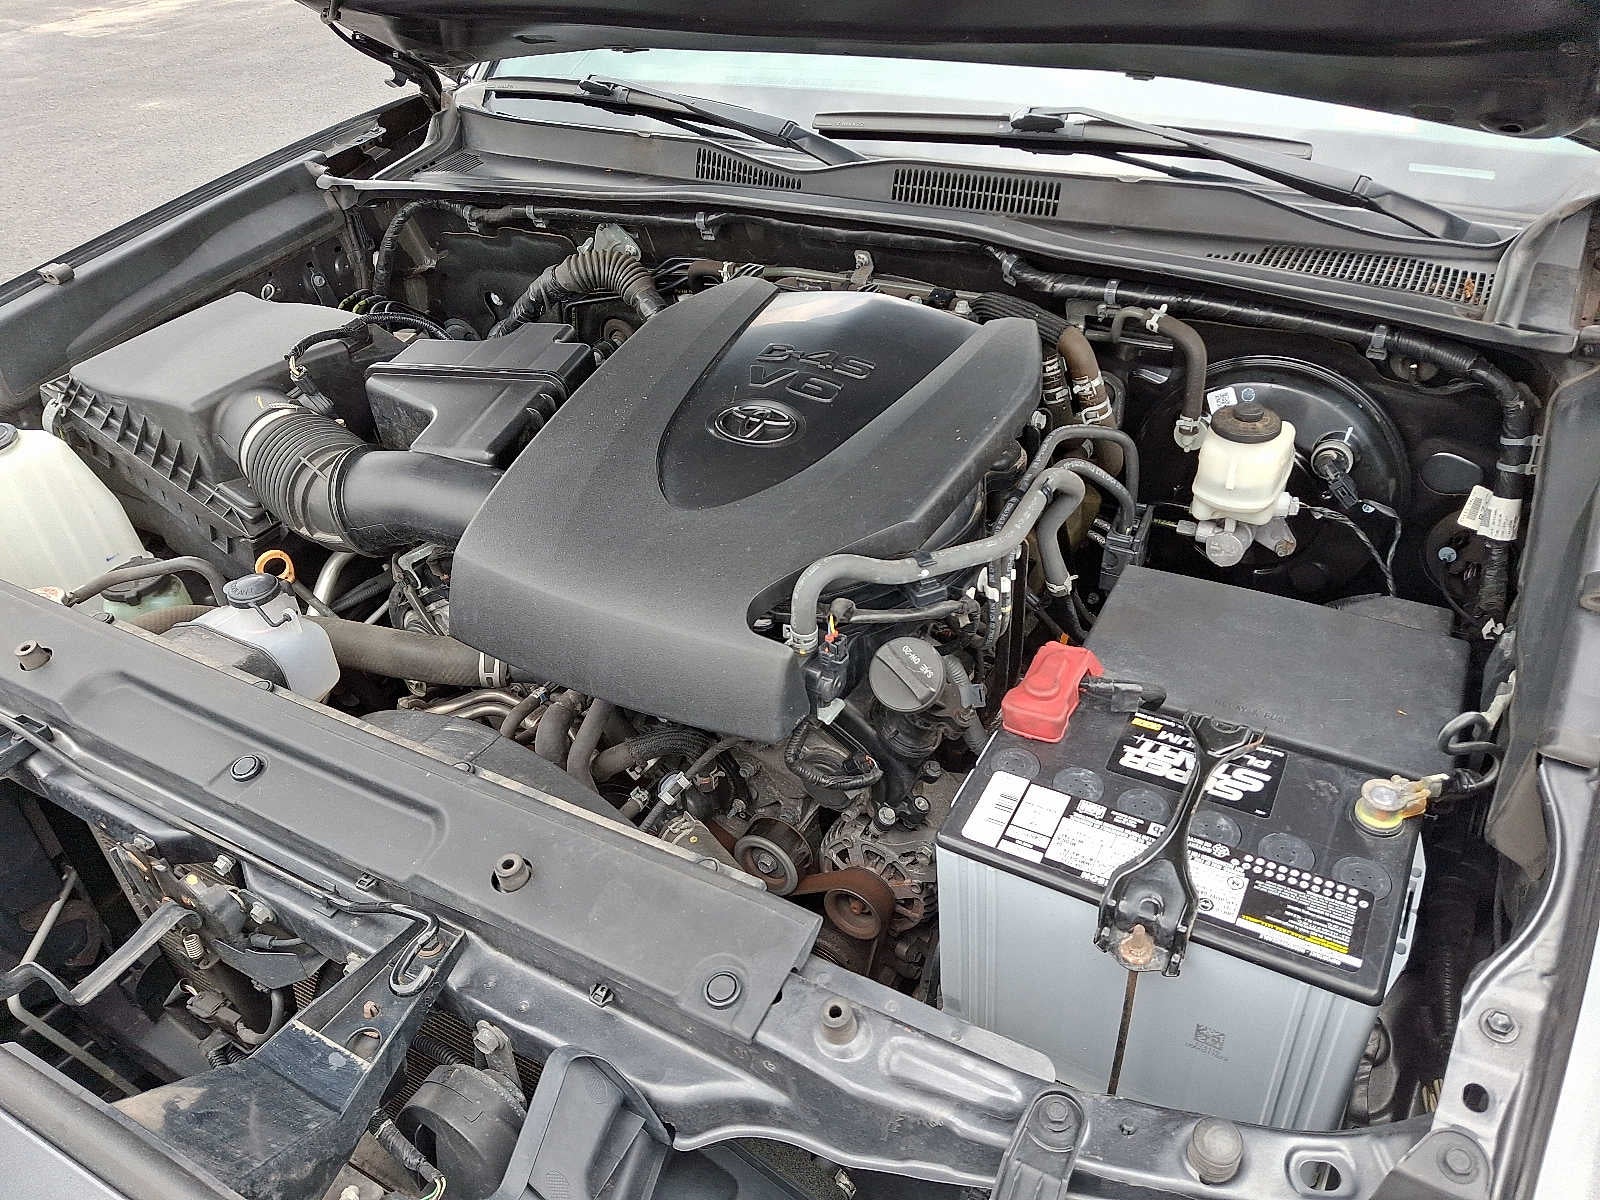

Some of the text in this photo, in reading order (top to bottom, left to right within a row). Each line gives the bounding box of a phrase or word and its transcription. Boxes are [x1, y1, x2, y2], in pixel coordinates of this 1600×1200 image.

[755, 343, 876, 380] D-4S
[749, 365, 844, 403] V6
[920, 663, 934, 678] SAE
